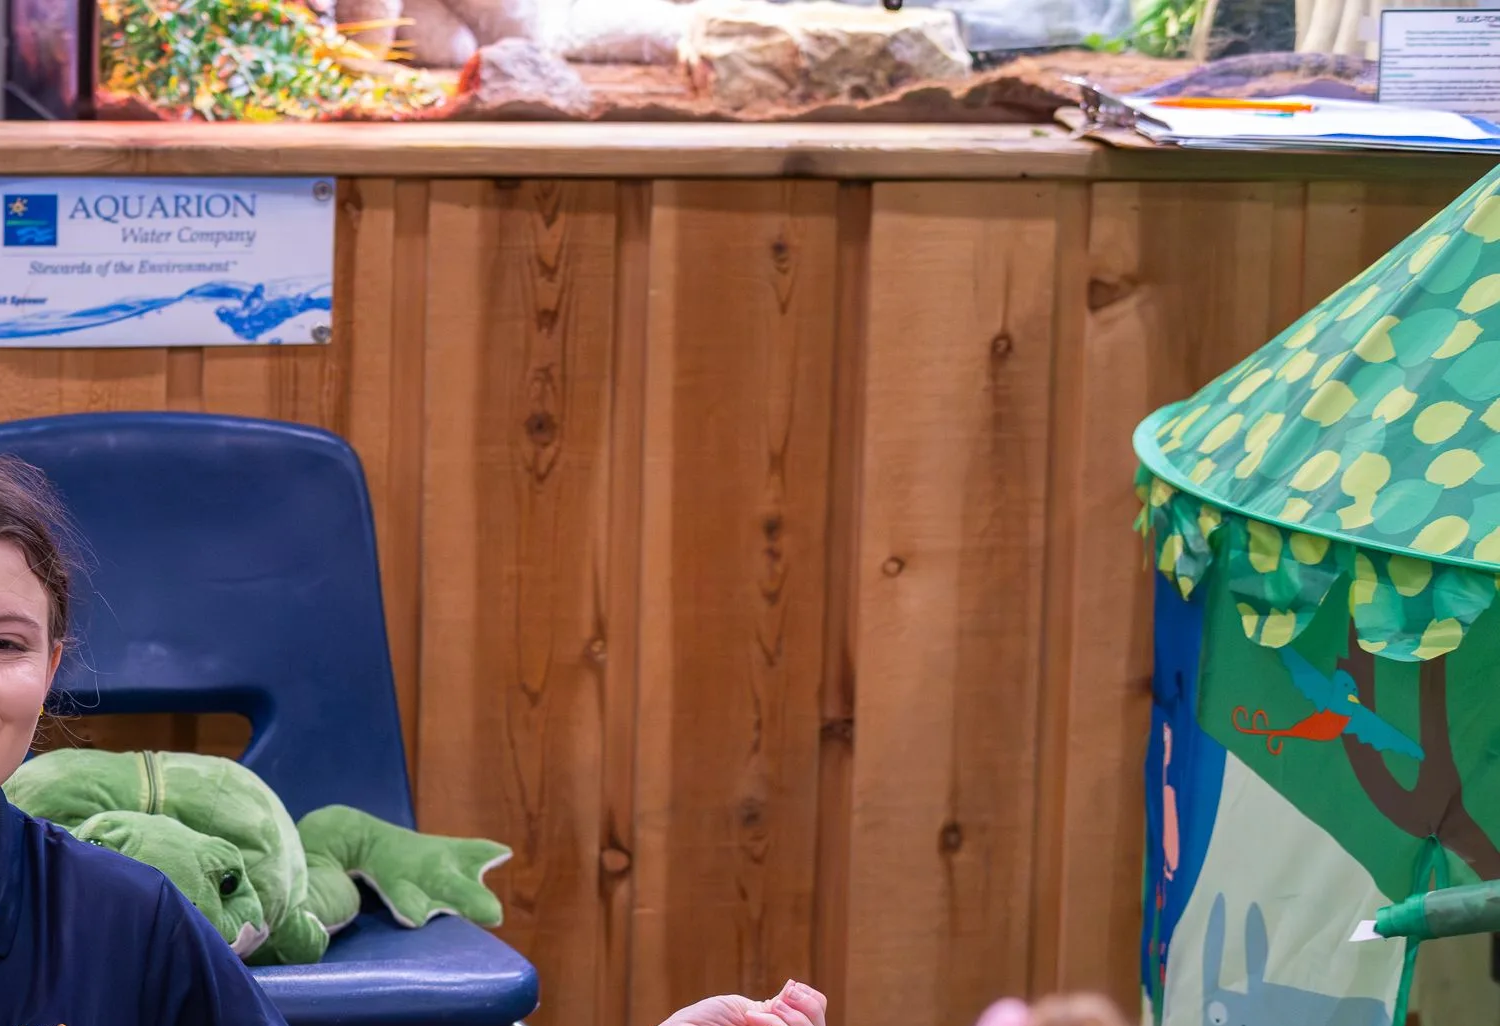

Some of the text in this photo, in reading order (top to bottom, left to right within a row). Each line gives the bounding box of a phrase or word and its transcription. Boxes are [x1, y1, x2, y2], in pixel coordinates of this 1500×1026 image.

[68, 193, 258, 224] AQUARION
[120, 226, 257, 248] Water Company
[28, 260, 93, 276] Stewards
[95, 260, 111, 278] of
[113, 260, 134, 275] the
